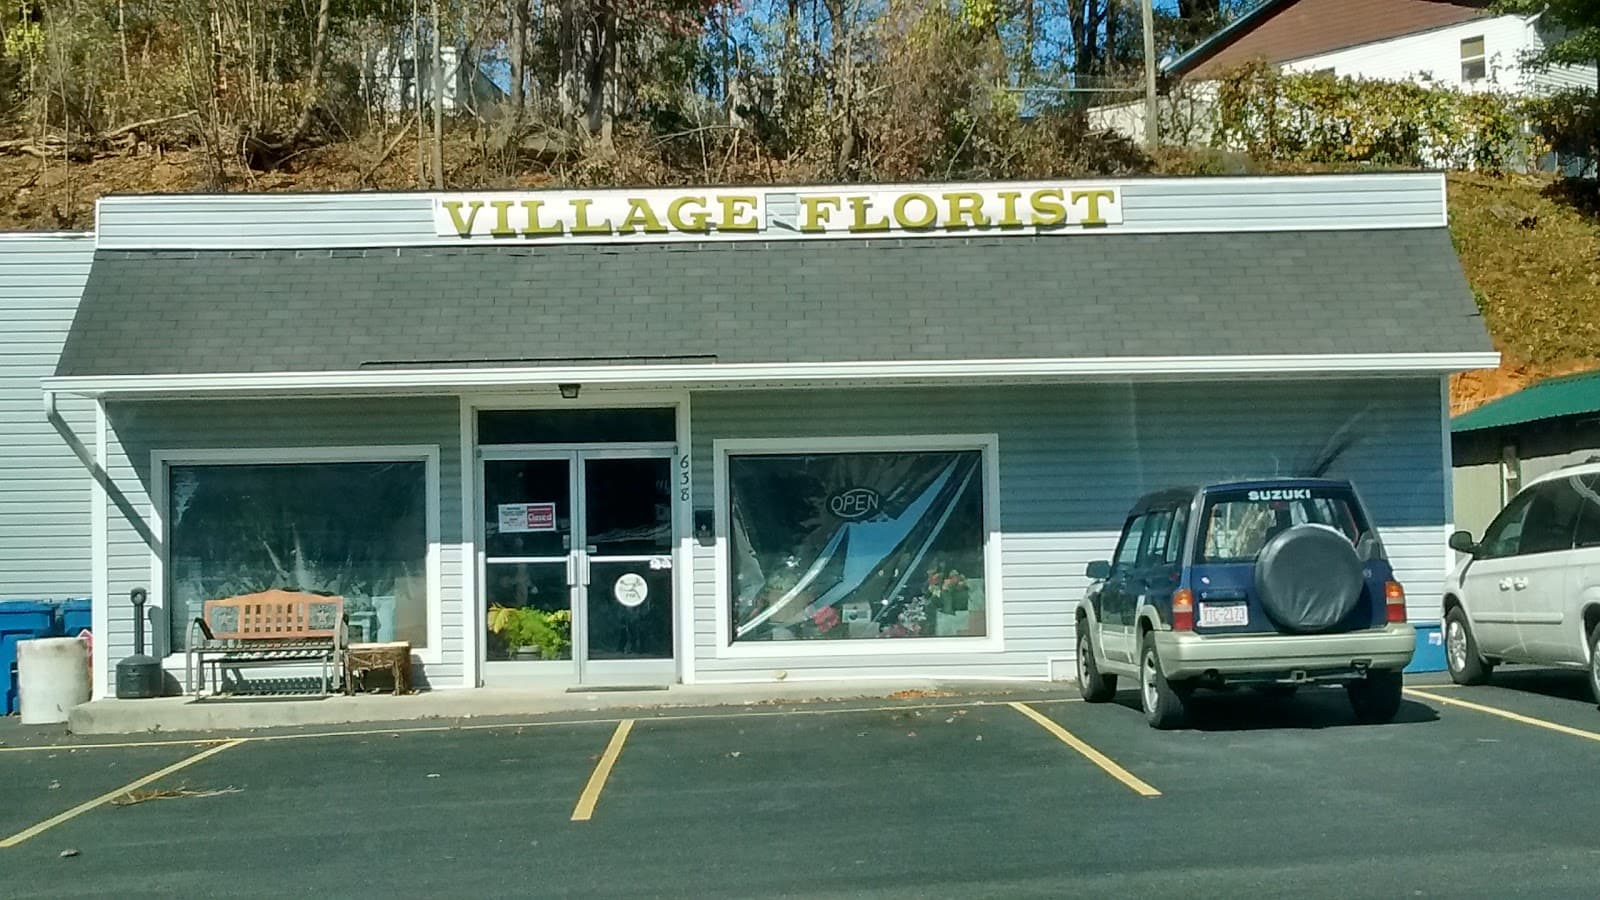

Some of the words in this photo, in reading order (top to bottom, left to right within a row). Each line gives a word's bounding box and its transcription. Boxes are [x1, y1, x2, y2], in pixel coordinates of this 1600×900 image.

[442, 194, 759, 237] VILLAGE
[799, 188, 1115, 232] FLORIST
[680, 454, 690, 502] 638
[831, 494, 879, 512] OPEN
[1247, 489, 1311, 501] SUZUKI
